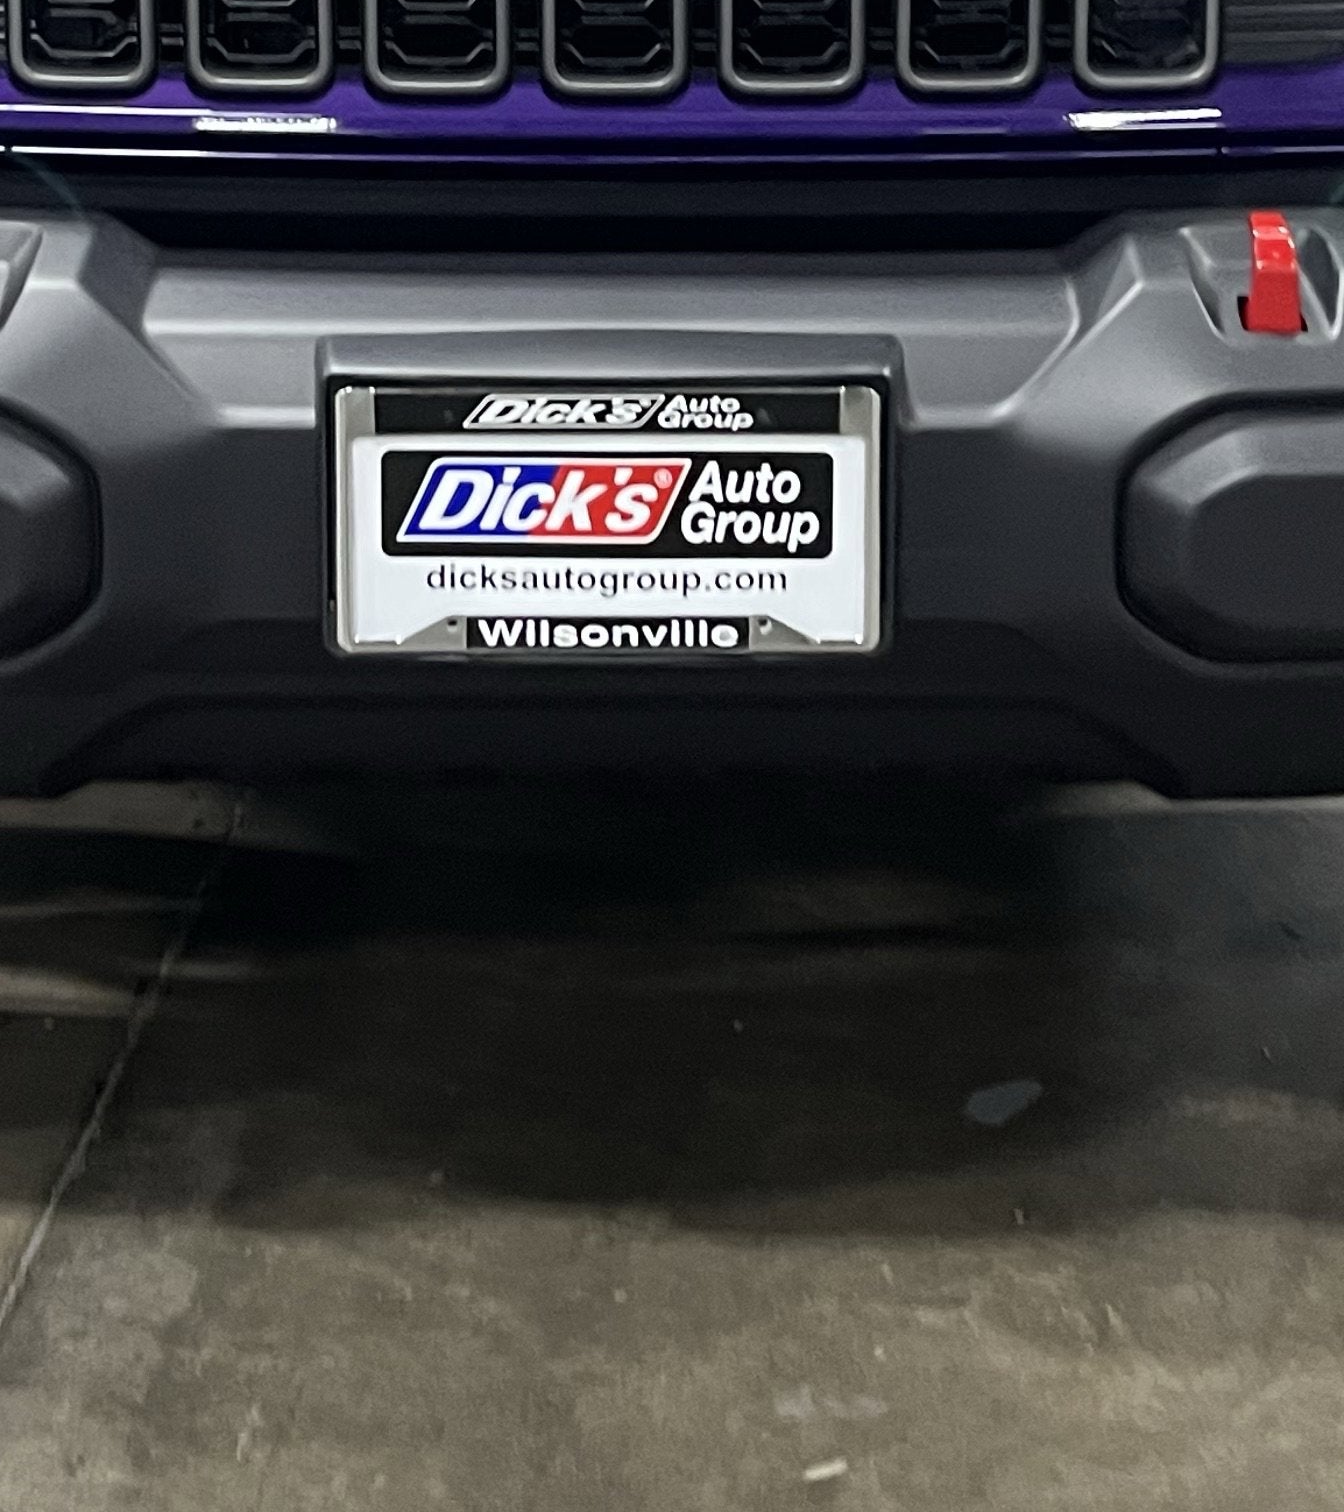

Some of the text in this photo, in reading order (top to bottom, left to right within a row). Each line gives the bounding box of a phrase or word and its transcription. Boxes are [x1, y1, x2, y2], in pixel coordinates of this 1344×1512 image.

[664, 394, 741, 413] Auto
[657, 410, 754, 431] Group
[689, 460, 801, 504] Auto
[418, 467, 658, 531] Dick's
[680, 500, 820, 552] Group
[426, 564, 788, 597] dicksautogroup.com
[477, 619, 739, 648] Wilsonville
